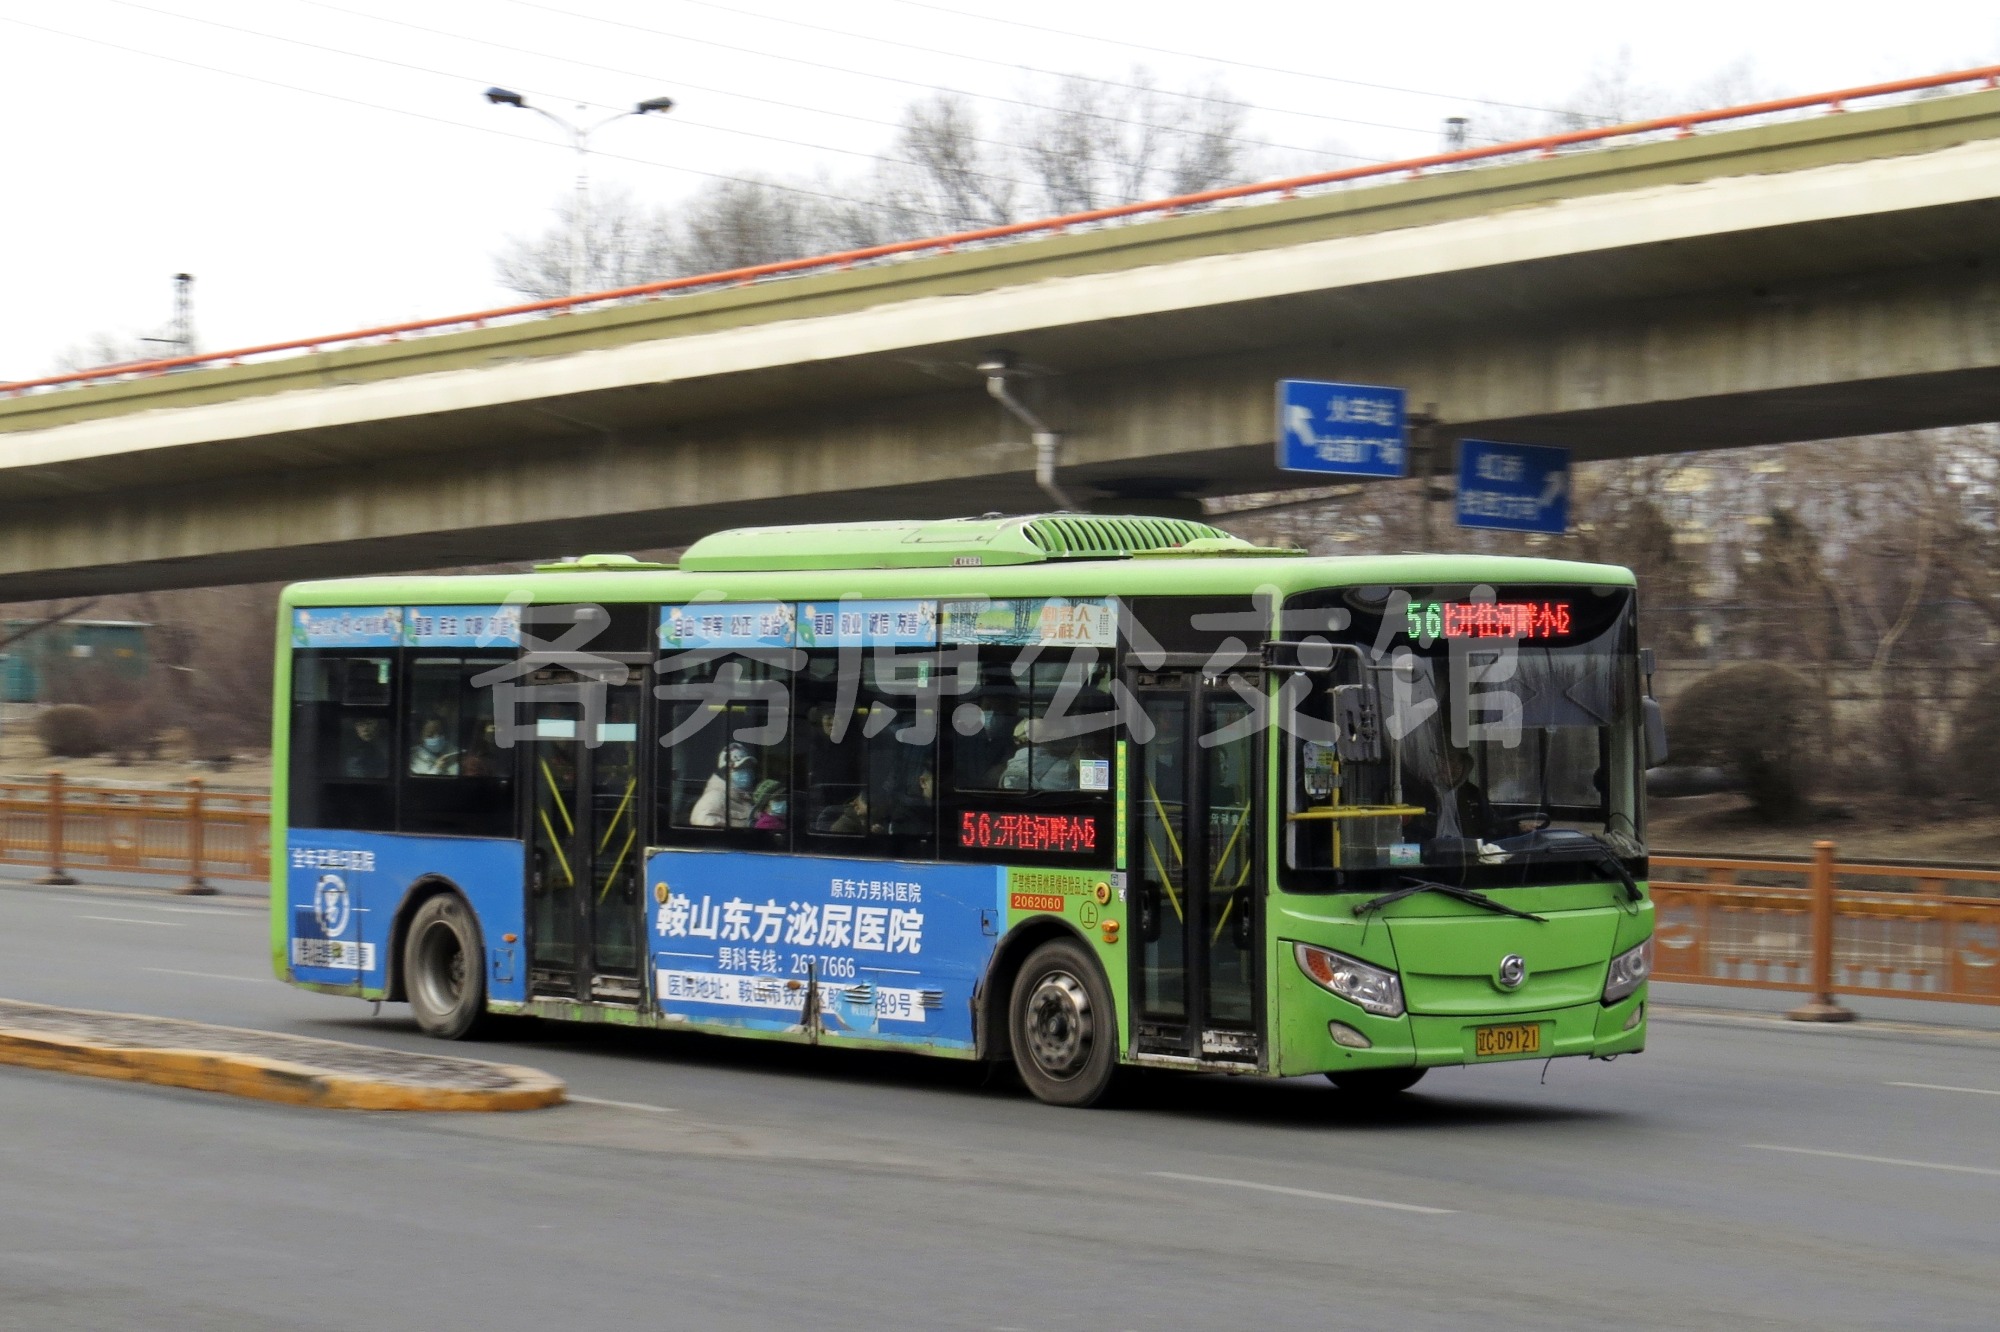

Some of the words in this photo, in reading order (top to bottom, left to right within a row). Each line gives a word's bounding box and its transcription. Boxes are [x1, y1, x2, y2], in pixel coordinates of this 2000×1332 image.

[1407, 603, 1441, 638] 56
[962, 812, 991, 846] 56
[994, 815, 1095, 851] 开往河畔小区
[831, 879, 921, 903] 原东方男科医院
[1014, 895, 1061, 909] 2062060
[656, 893, 924, 954] 鞍山东方泌尿医院
